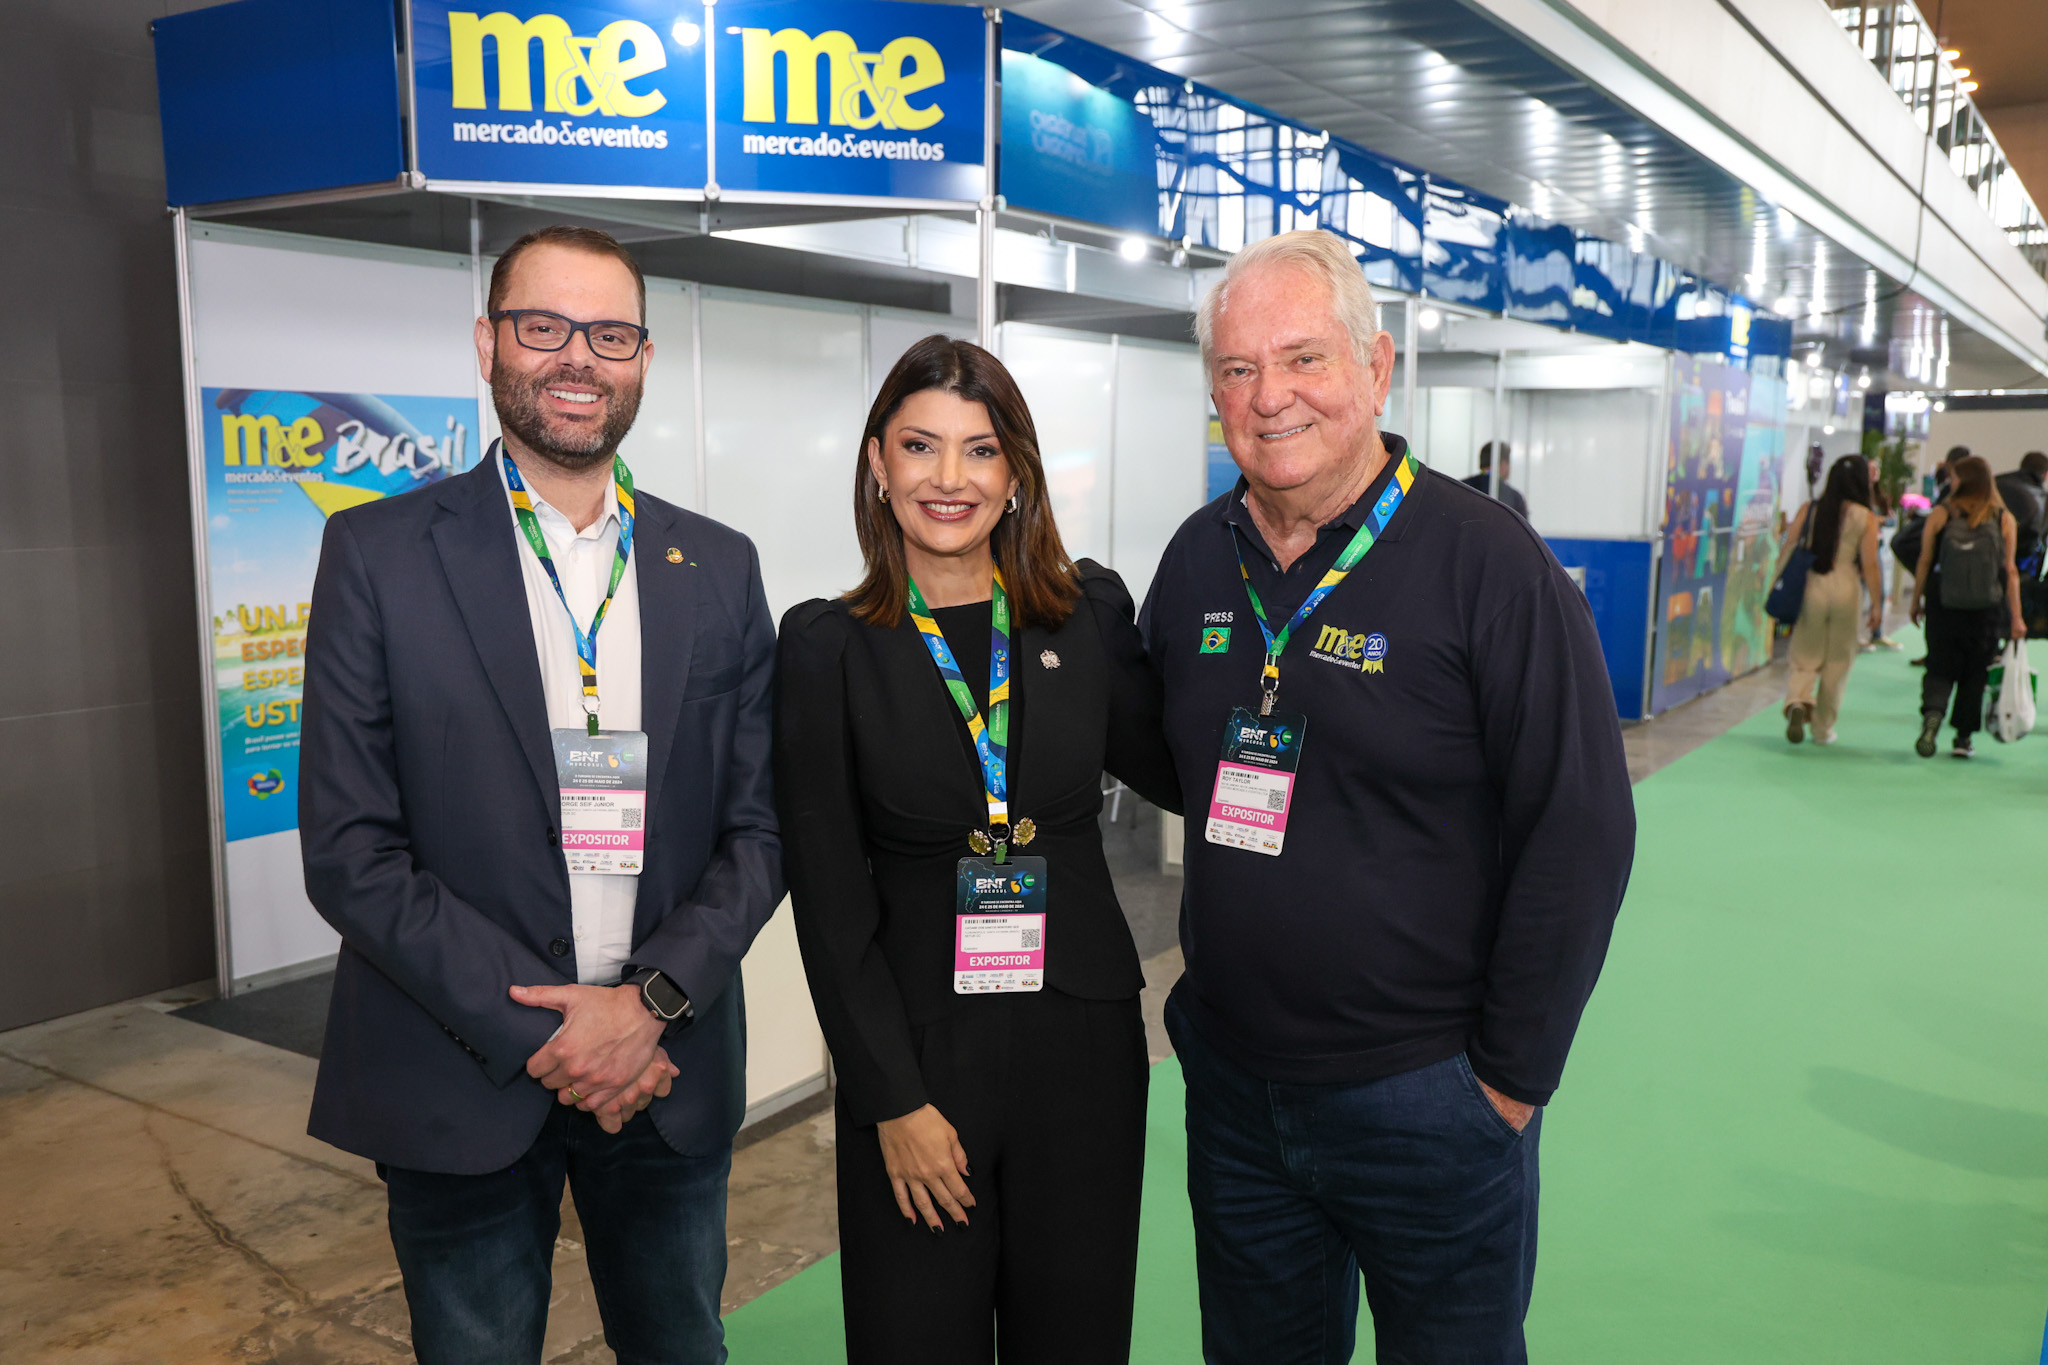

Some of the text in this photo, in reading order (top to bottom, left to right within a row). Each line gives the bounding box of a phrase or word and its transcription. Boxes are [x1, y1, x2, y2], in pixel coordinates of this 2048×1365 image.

[448, 9, 668, 117] m&e
[742, 27, 945, 130] m&e
[453, 119, 669, 149] mercado&eventos
[743, 132, 945, 161] mercado&eventos
[221, 414, 324, 467] m&e
[332, 415, 467, 480] Brasil
[224, 470, 325, 484] mercado&eventos
[239, 603, 286, 632] UN
[1204, 612, 1234, 624] PRESS
[1314, 624, 1366, 659] m&e
[1367, 638, 1383, 650] 20
[1309, 650, 1361, 670] mercado&eventos
[243, 666, 305, 690] ESPE
[1240, 727, 1268, 740] BNT
[570, 750, 604, 762] BNT
[1222, 806, 1274, 825] EXPOSITOR
[562, 833, 629, 845] EXPOSITOR
[976, 878, 1007, 889] BNT
[969, 955, 1030, 966] EXPOSITOR
